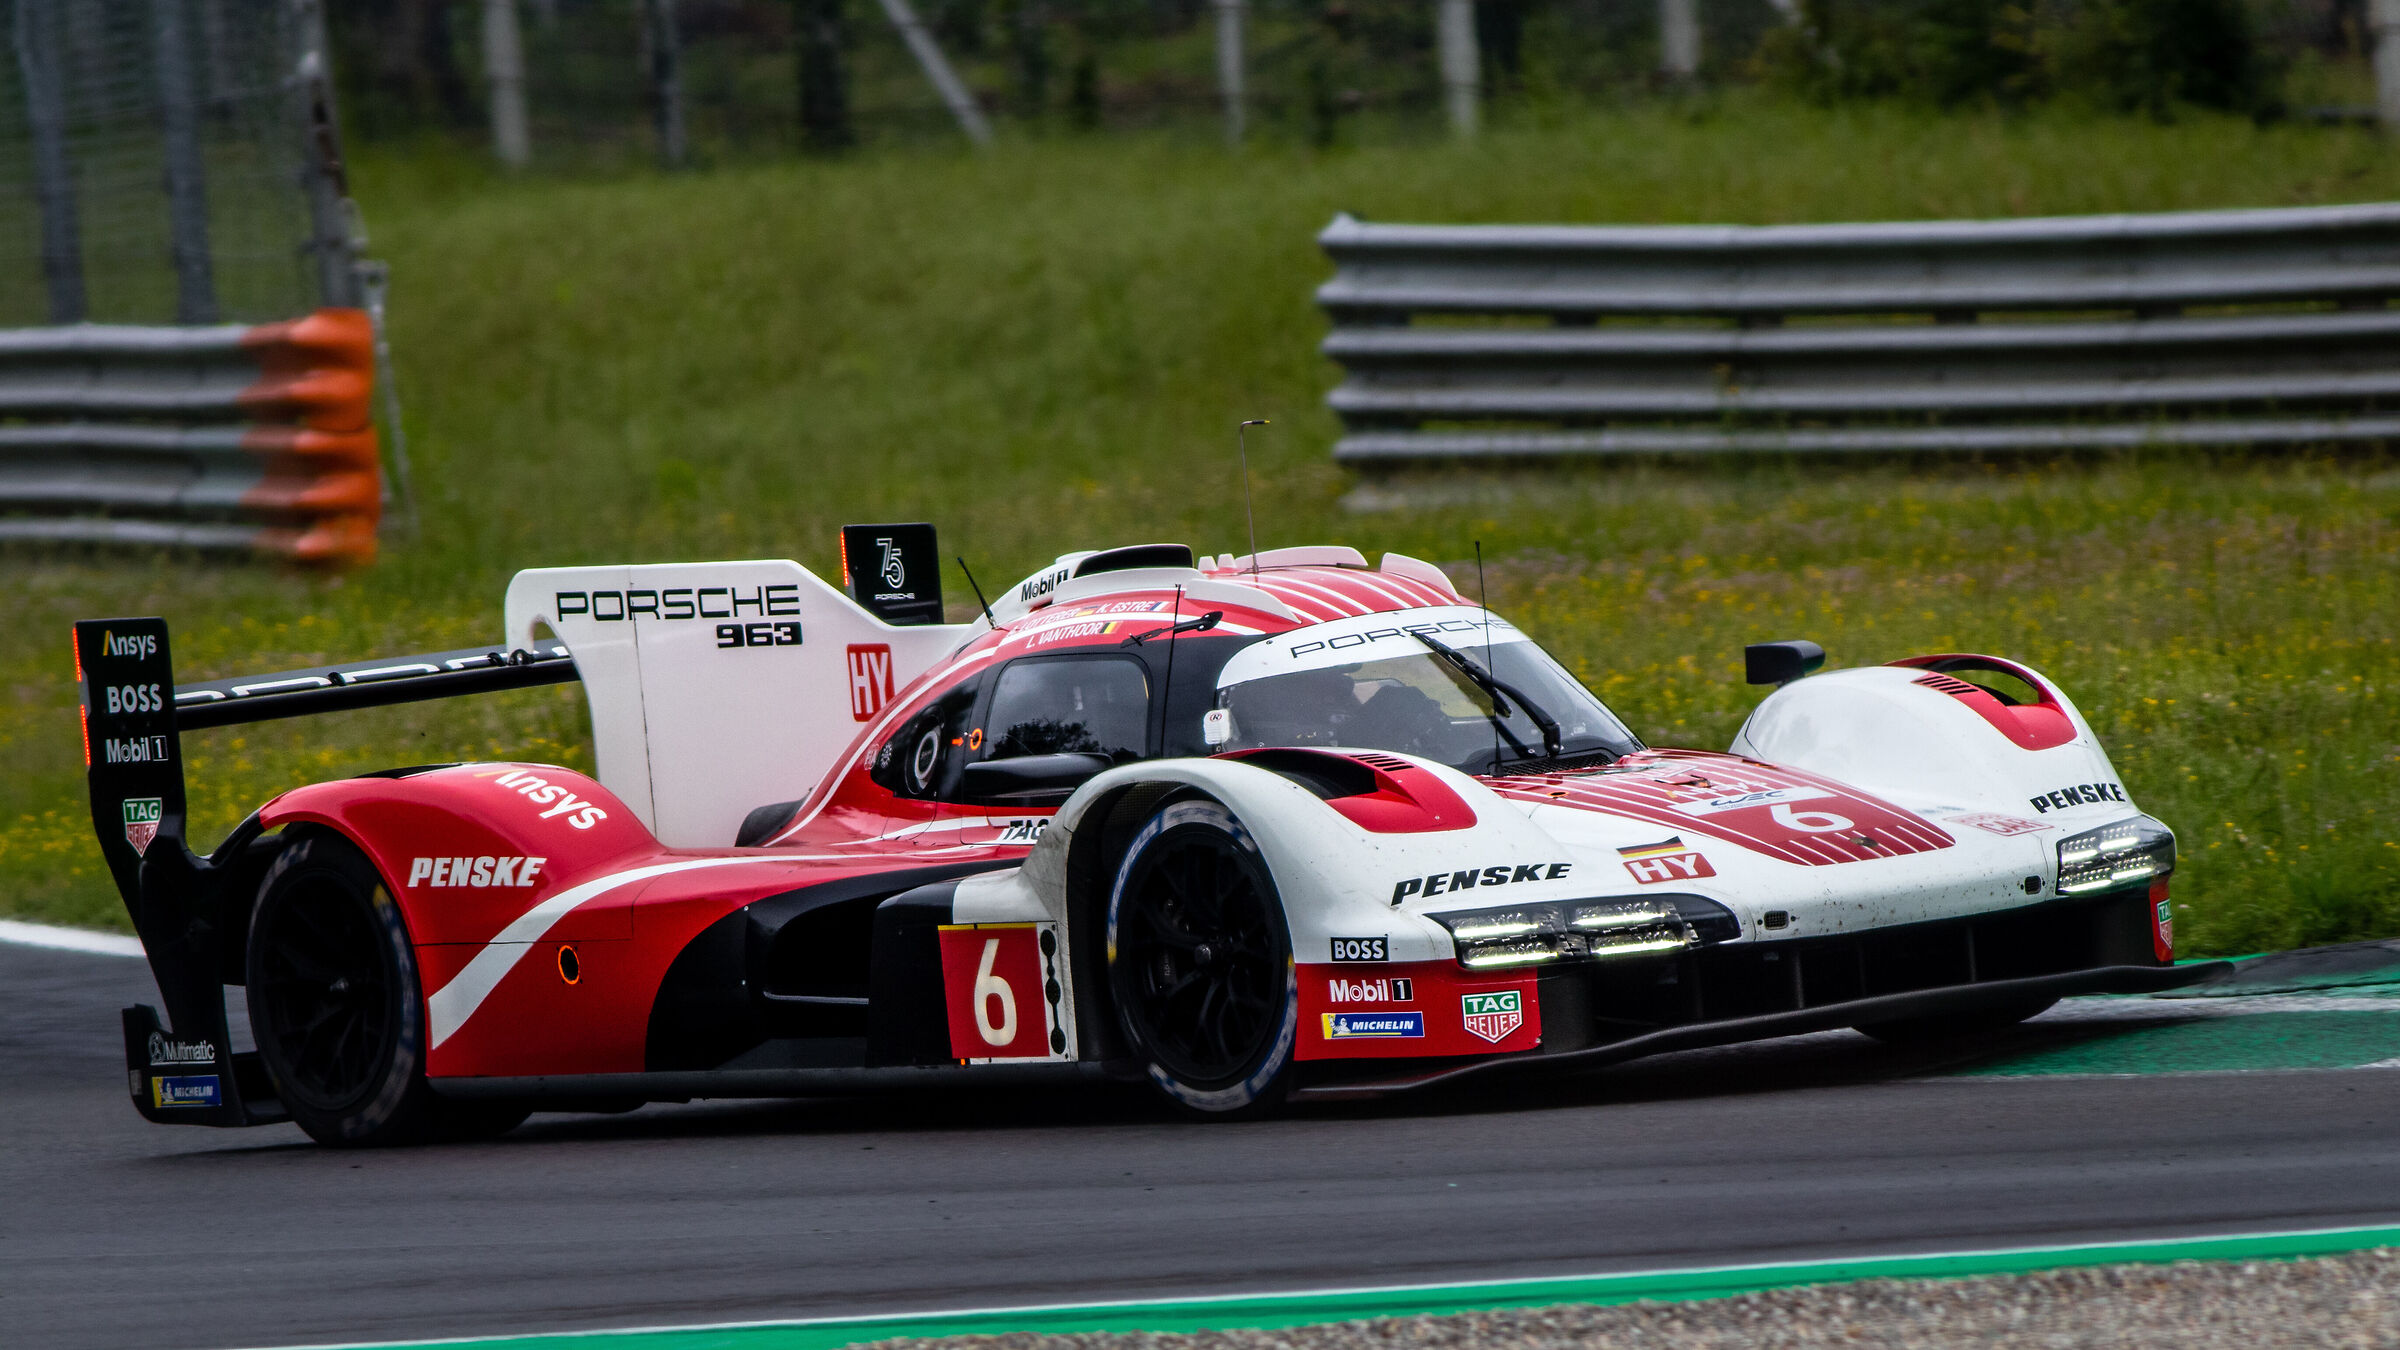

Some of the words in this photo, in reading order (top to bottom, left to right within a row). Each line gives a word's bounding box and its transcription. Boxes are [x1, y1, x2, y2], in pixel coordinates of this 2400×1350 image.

[876, 537, 905, 589] 75
[875, 592, 916, 600] PORSCHE
[1021, 573, 1055, 602] Mobil
[556, 584, 801, 622] PORSCHE
[1096, 602, 1112, 614] K.
[1112, 601, 1152, 612] ESTRE
[102, 630, 157, 660] Ansys
[716, 621, 803, 648] 963
[1025, 636, 1036, 649] L.
[1038, 622, 1104, 646] VANTHOOR
[1290, 619, 1514, 659] PORSCHE
[851, 652, 890, 714] HY
[106, 683, 163, 713] BOSS
[105, 737, 151, 763] Mobil
[127, 802, 159, 820] TAG
[473, 768, 608, 830] Ansys
[2030, 783, 2126, 814] PENSKE
[1770, 804, 1855, 832] 6
[128, 823, 156, 850] HEUER
[407, 856, 547, 888] PENSKE
[1629, 853, 1700, 881] HY
[1390, 863, 1572, 907] PENSKE
[1334, 939, 1384, 960] BOSS
[973, 938, 1017, 1047] 6
[1329, 978, 1389, 1002] Mobil
[1467, 995, 1515, 1013] TAG
[1352, 1020, 1414, 1030] MICHELIN
[1467, 1013, 1518, 1043] HEUER
[165, 1040, 215, 1061] Multimatic
[174, 1085, 214, 1097] MICHELIN
